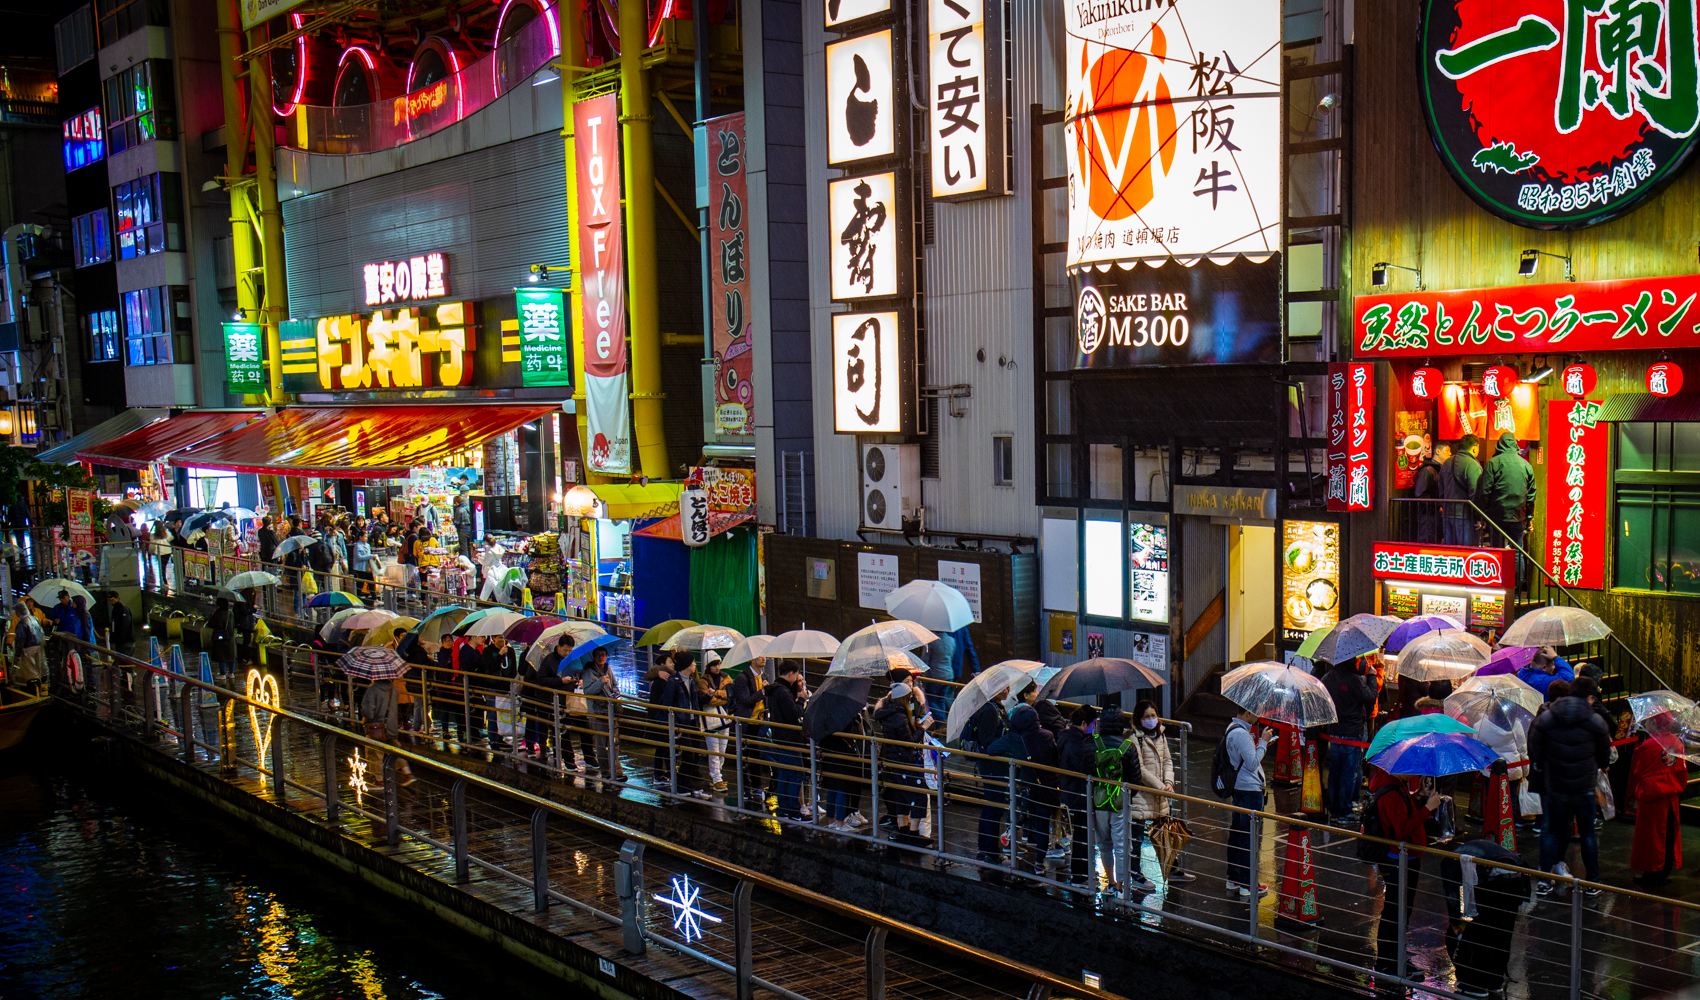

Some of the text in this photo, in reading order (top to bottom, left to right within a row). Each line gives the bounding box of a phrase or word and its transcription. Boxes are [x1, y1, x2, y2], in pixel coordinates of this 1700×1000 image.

[1098, 21, 1135, 39] Dotonbori
[1435, 0, 1700, 139] 一蘭
[1187, 50, 1242, 211] 松阪牛
[1518, 148, 1656, 213] 昭和35年創業
[588, 116, 611, 359] Tax Free
[717, 130, 746, 338] とんぼり
[1109, 293, 1188, 313] SAKE BAR
[521, 302, 560, 341] 薬
[1108, 314, 1189, 347] M300
[1361, 288, 1700, 351] 天然とんこつラーメン
[227, 332, 258, 361] 薬
[523, 344, 562, 352] Medicine
[1411, 370, 1428, 397] 一蘭
[1483, 369, 1500, 396] 一蘭
[1566, 366, 1584, 396] 一蘭
[1650, 365, 1668, 396] 一蘭
[707, 484, 752, 507] たこ焼き
[1186, 493, 1261, 510] INAKA KAIKAN
[690, 496, 708, 543] とんぼり
[1375, 550, 1497, 578] お土産販売所 はい
